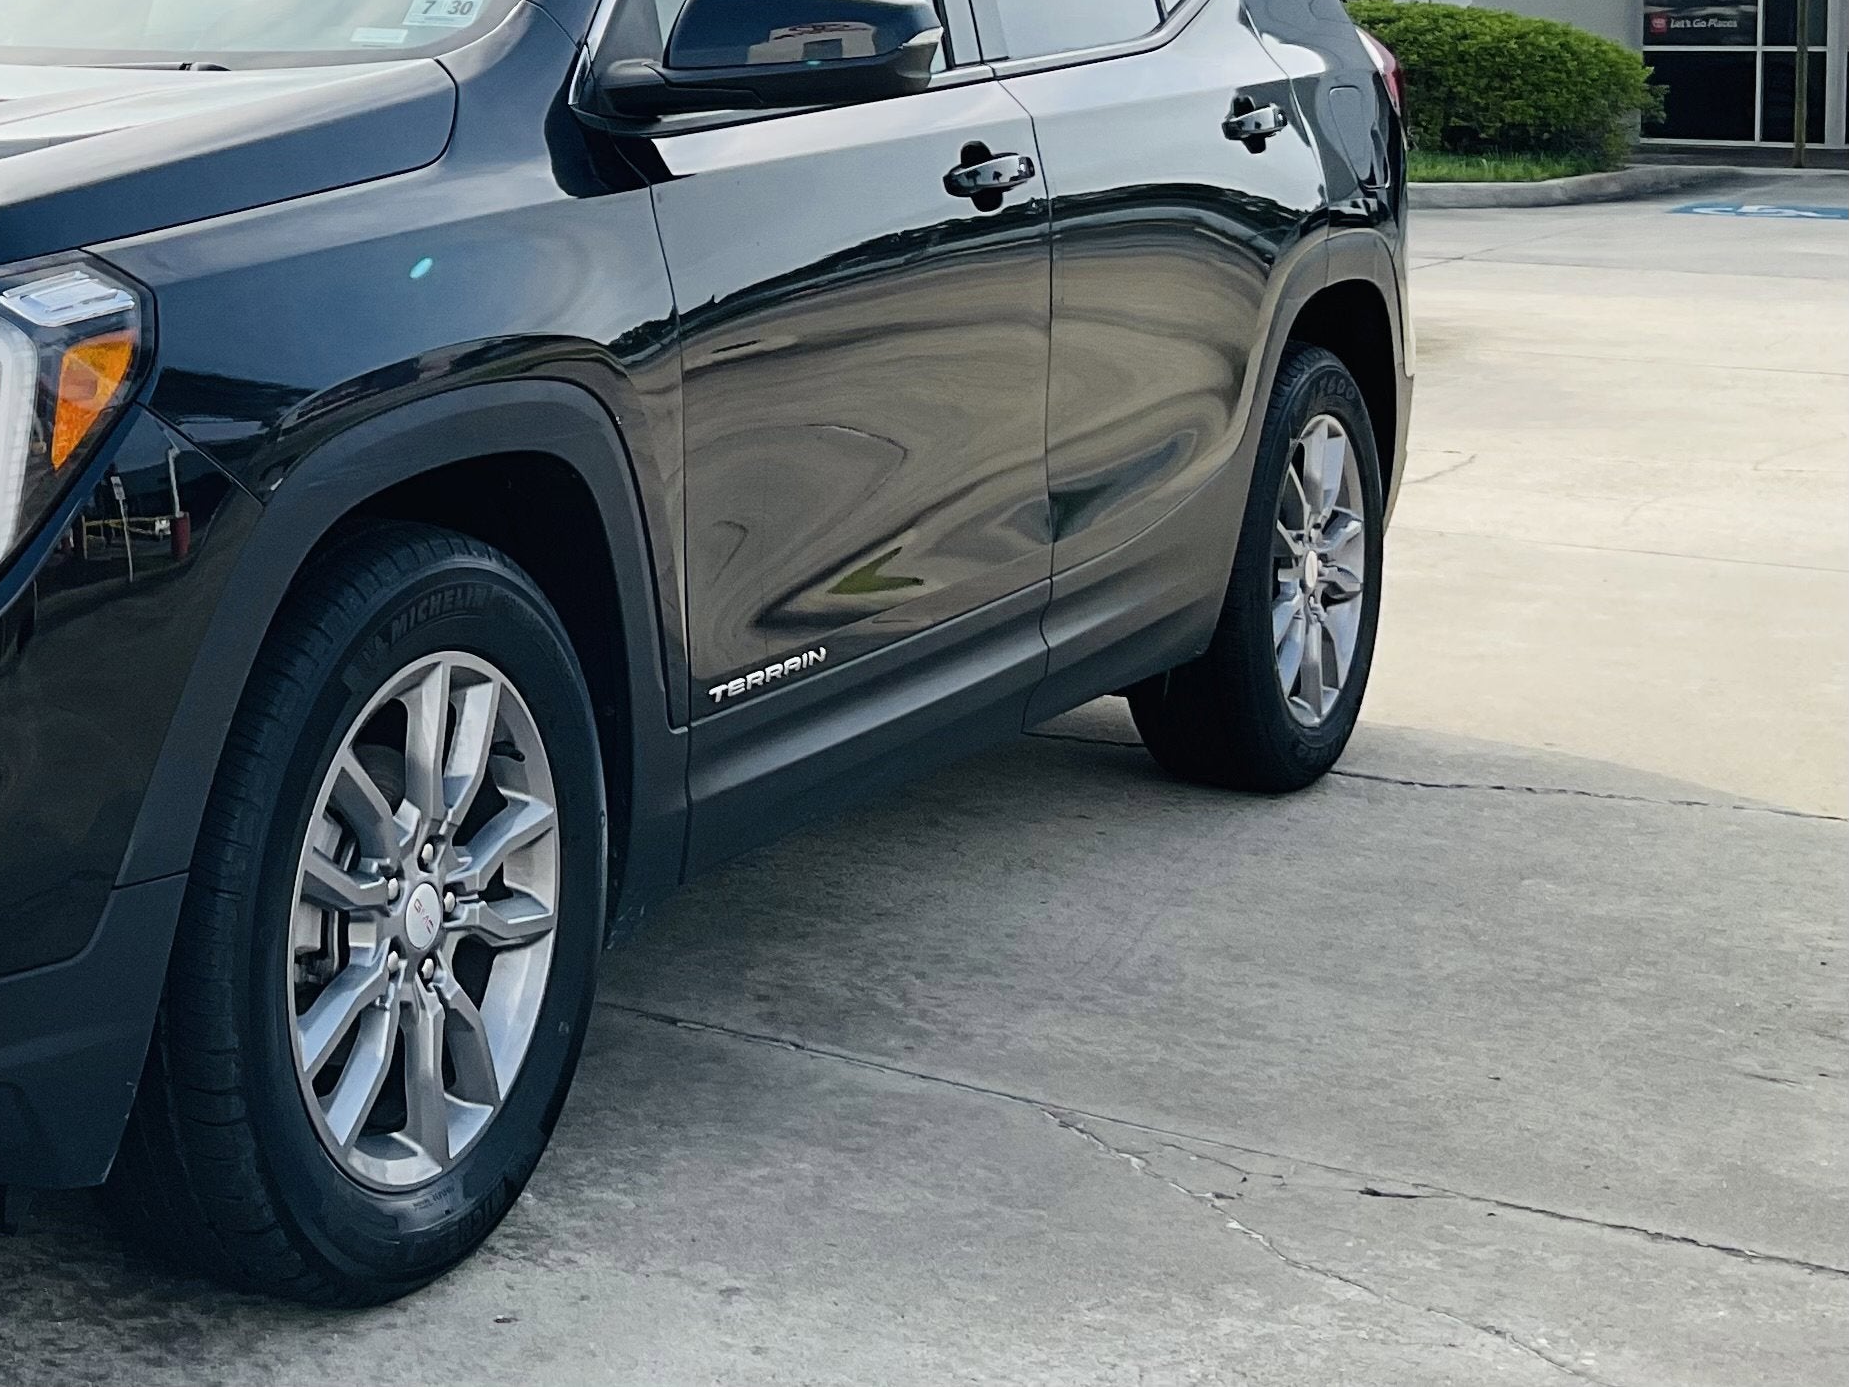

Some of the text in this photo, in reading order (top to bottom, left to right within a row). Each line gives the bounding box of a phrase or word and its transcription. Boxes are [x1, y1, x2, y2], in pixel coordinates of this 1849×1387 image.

[422, 0, 474, 16] 7 30
[1692, 18, 1707, 29] Go
[390, 585, 489, 645] MICHELIN
[708, 646, 827, 704] TERRAIN
